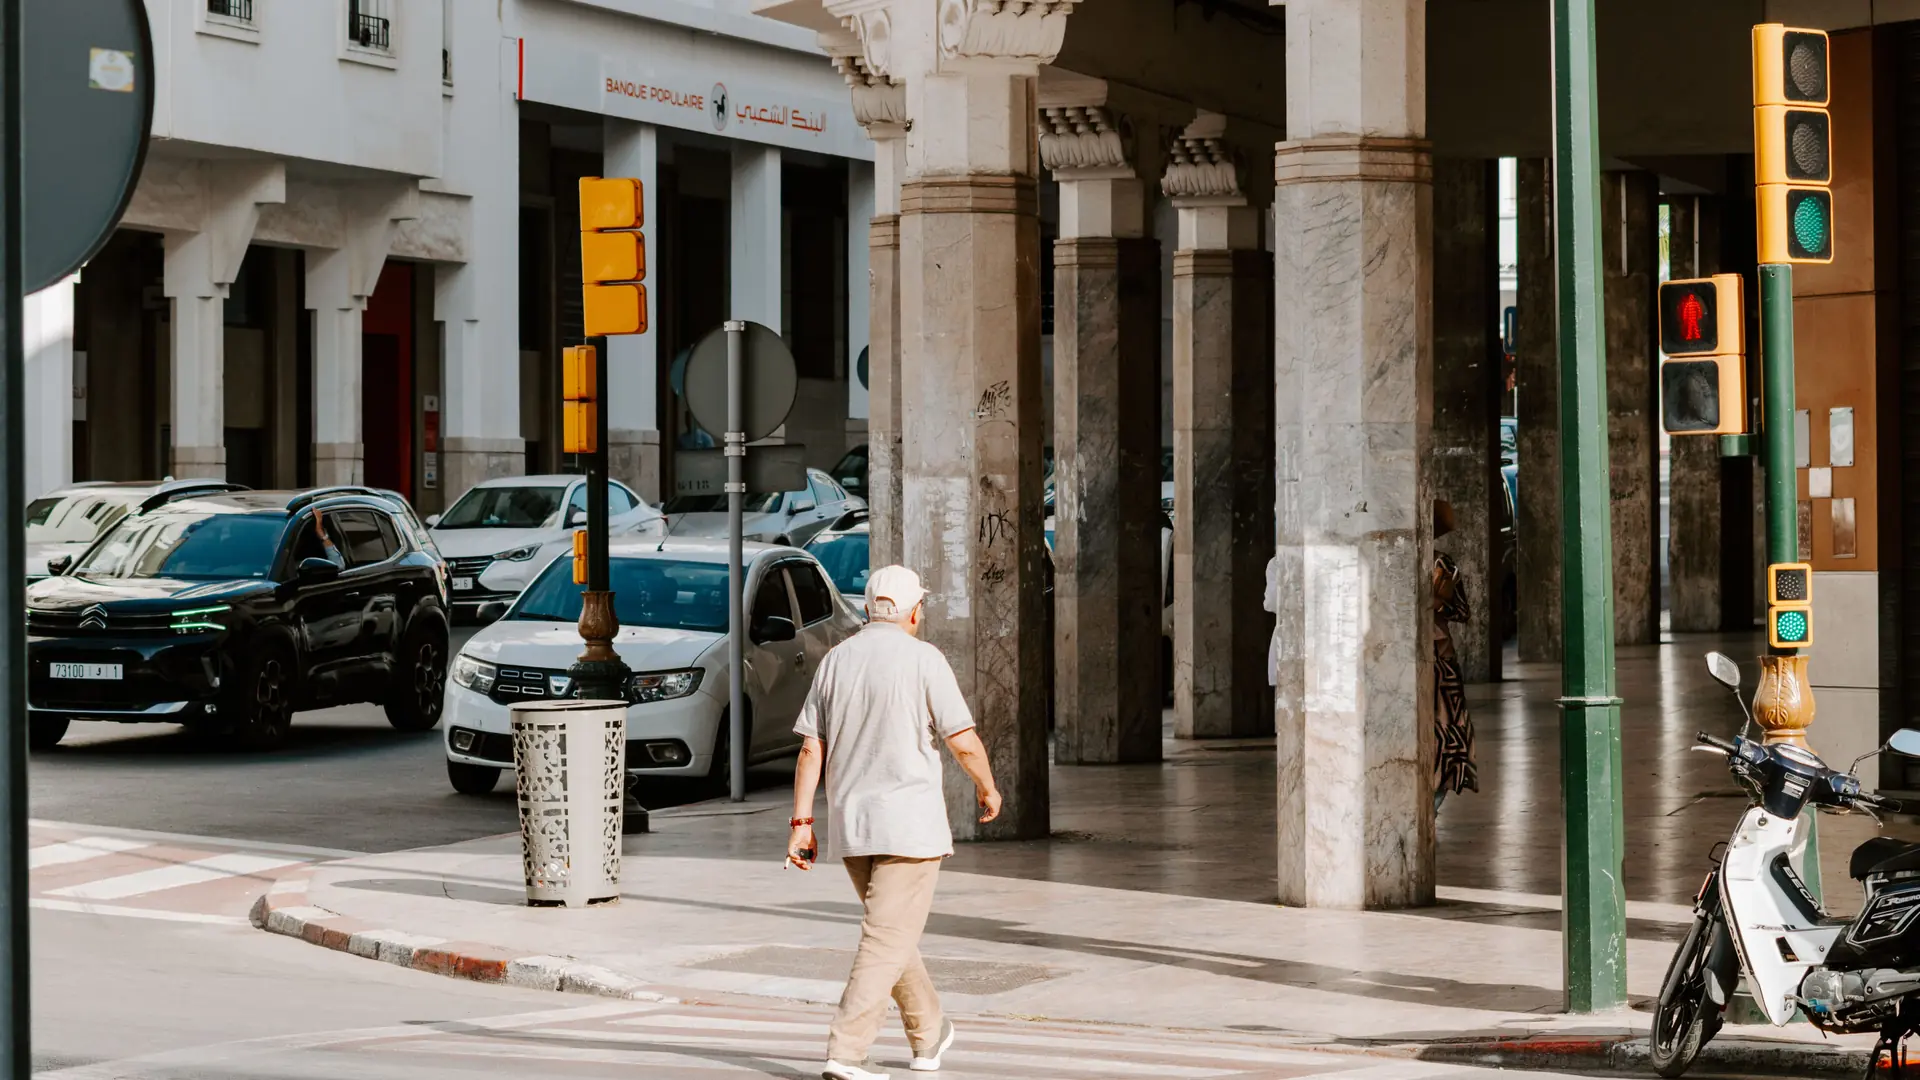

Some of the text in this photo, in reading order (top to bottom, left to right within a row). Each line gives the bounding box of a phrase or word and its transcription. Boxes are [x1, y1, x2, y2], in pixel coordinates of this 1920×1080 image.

[606, 78, 703, 110] BANQUE POPULAIRE
[736, 103, 826, 137] البنك الشعبي
[56, 664, 84, 678] 73100
[114, 665, 118, 678] 1
